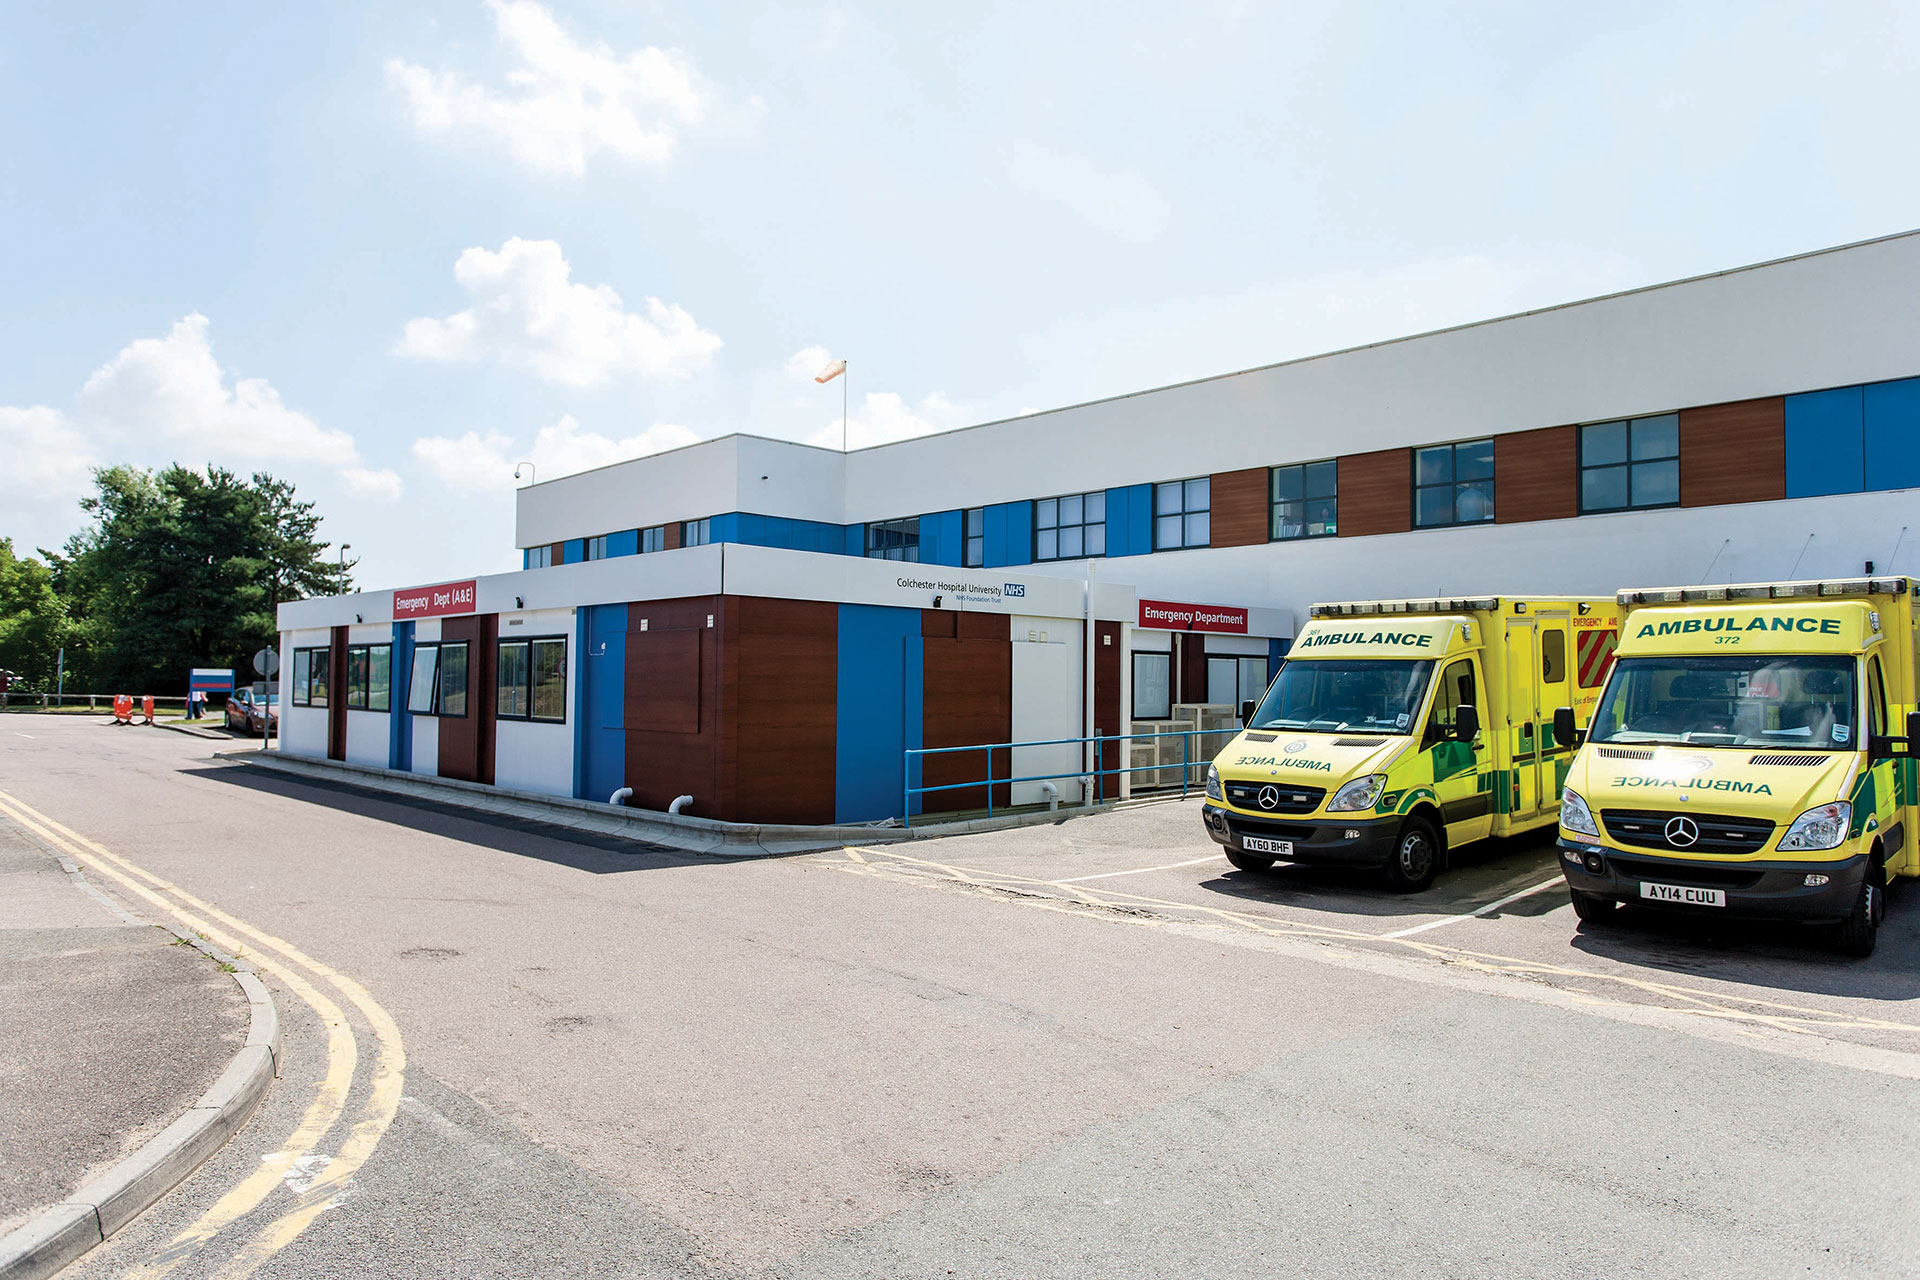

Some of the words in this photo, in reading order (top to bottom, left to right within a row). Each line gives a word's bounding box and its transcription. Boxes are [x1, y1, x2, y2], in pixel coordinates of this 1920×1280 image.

[896, 577, 936, 590] Colchester
[937, 581, 967, 593] Hospital
[968, 584, 1002, 597] University
[1004, 584, 1024, 597] NHS
[396, 596, 429, 612] Emergency
[433, 592, 450, 608] Dept
[452, 586, 473, 605] (A&E)
[966, 595, 990, 603] Foundation
[1145, 606, 1194, 624] Emergency
[1195, 610, 1243, 625] Department
[1573, 617, 1602, 627] EMERGENCY
[1636, 617, 1841, 639] AMBULANCE
[1300, 632, 1433, 649] AMBULANCE
[1714, 636, 1740, 645] 372
[1247, 838, 1268, 850] AY60
[1271, 841, 1289, 852] BHF
[1650, 885, 1681, 900] AY14
[1686, 889, 1715, 903] CUU
